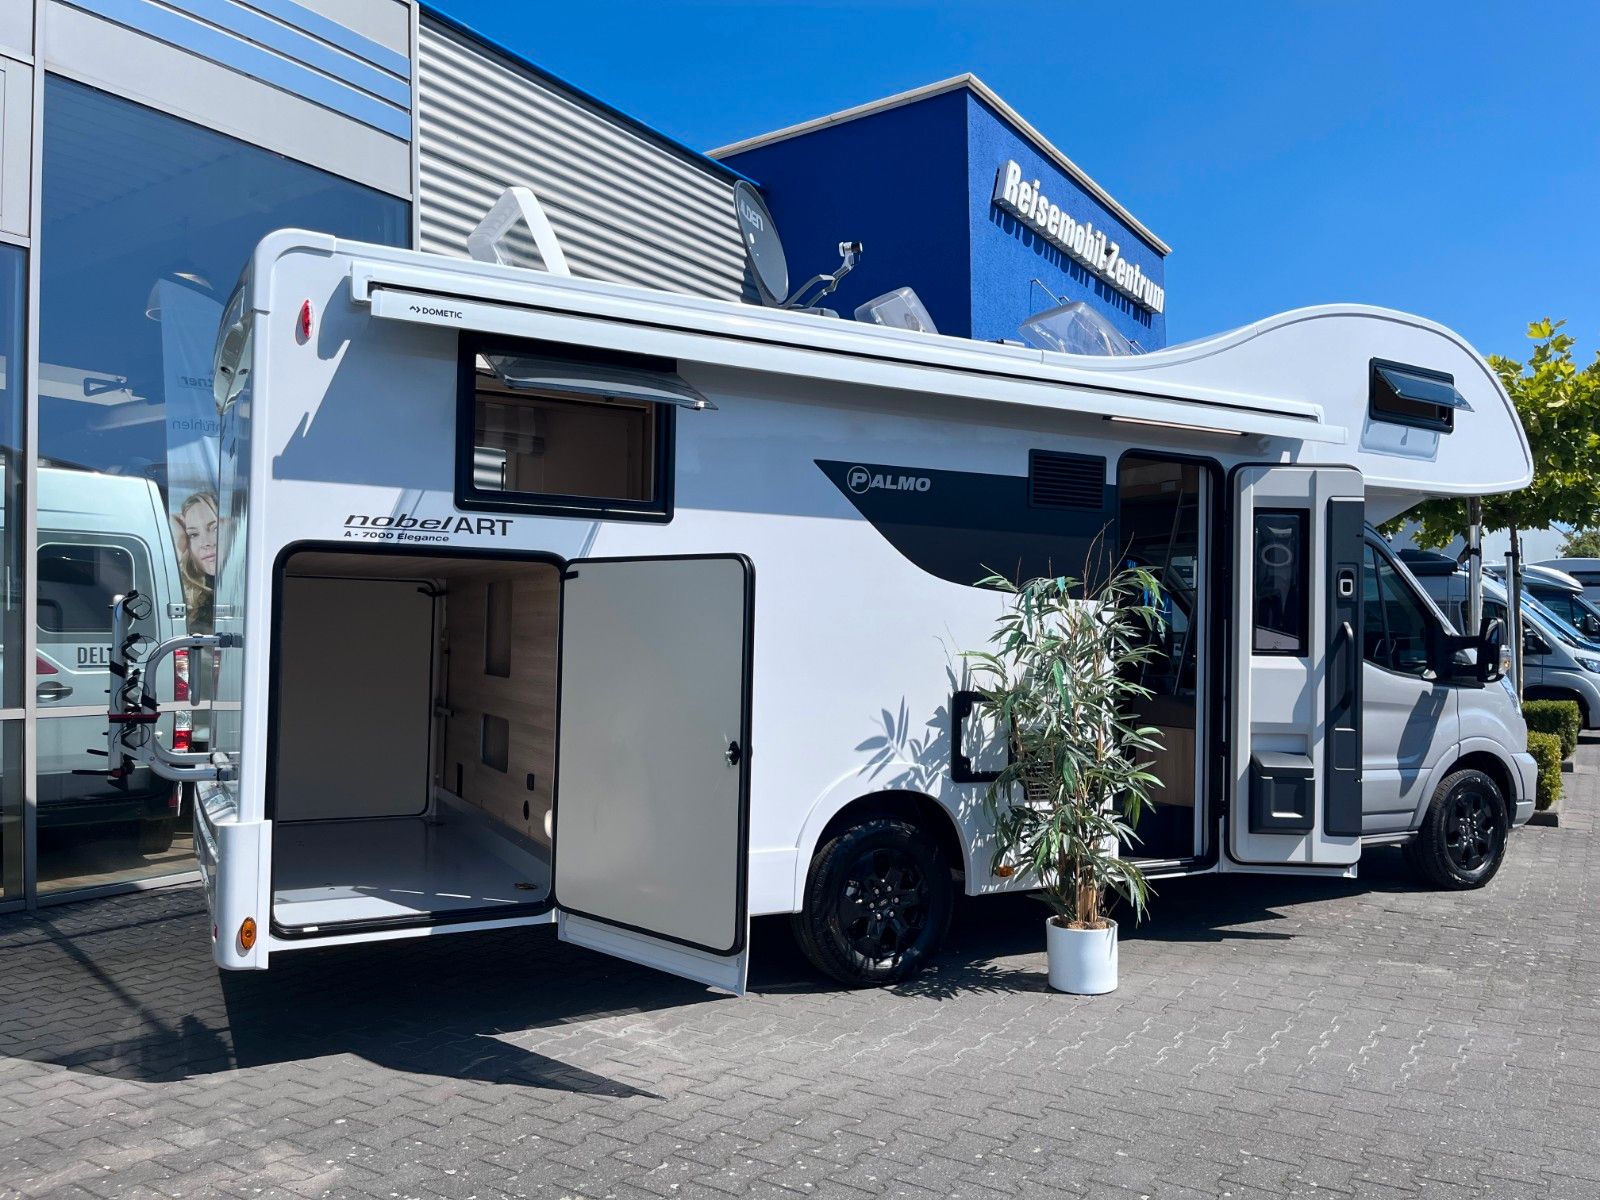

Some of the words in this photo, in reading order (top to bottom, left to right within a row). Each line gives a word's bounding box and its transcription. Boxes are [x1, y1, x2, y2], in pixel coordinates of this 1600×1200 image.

[1002, 159, 1165, 313] Reisemobil-Zentrum
[422, 307, 463, 319] DOMETIC
[847, 468, 931, 493] PALMO
[344, 530, 352, 538] A
[362, 531, 394, 540] 7000
[397, 533, 450, 543] Elegance
